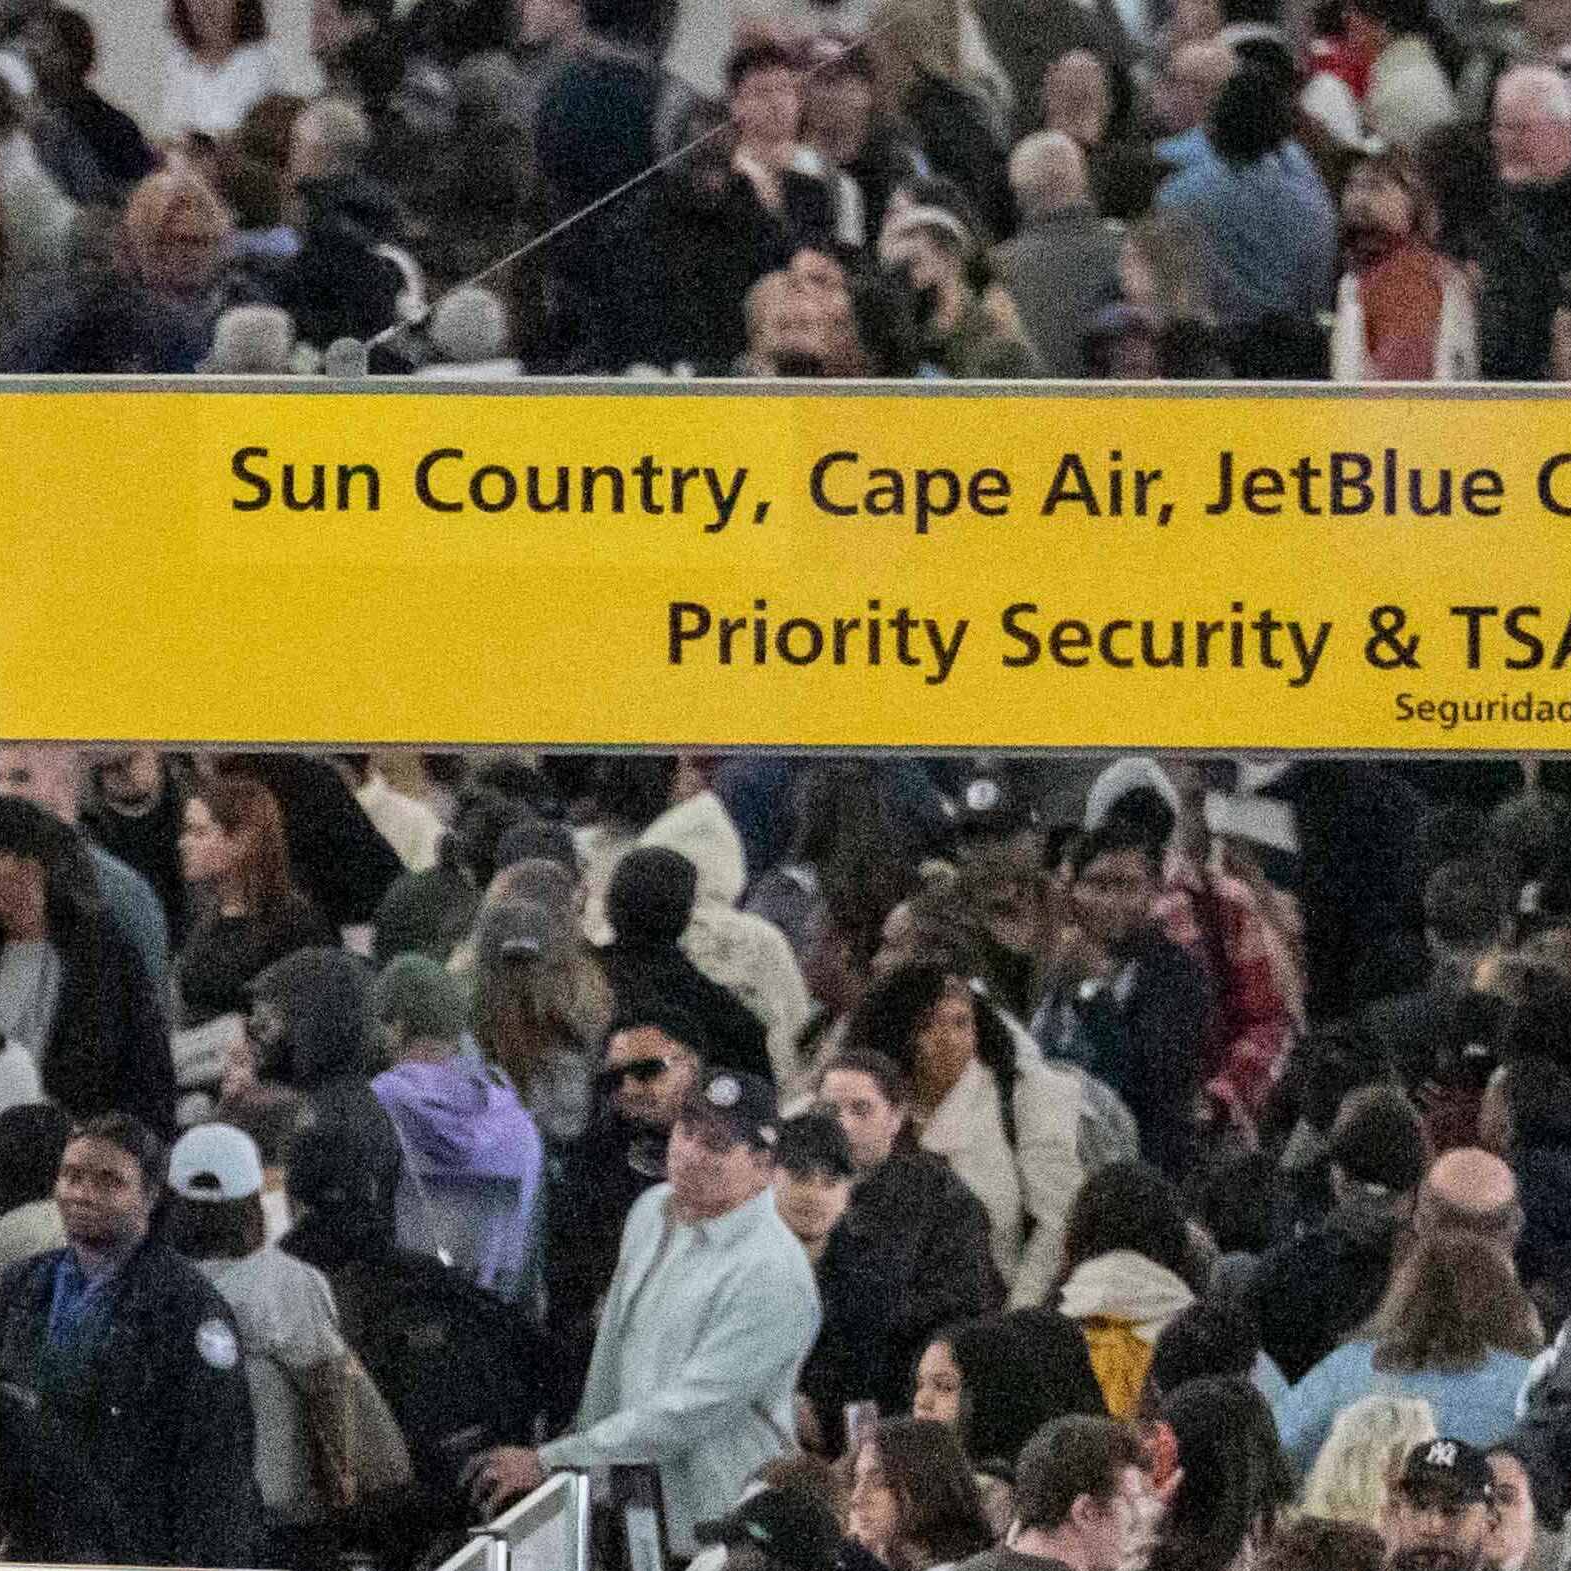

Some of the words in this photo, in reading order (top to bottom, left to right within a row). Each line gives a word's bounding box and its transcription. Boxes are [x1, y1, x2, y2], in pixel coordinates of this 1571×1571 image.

[232, 447, 380, 511] Sun
[415, 448, 769, 533] Country,
[810, 451, 1011, 534] Cape
[1042, 450, 1173, 526] Air,
[1206, 449, 1504, 517] JetBlue
[669, 599, 968, 685] Priority
[1002, 602, 1332, 688] Security
[1365, 605, 1419, 670] &
